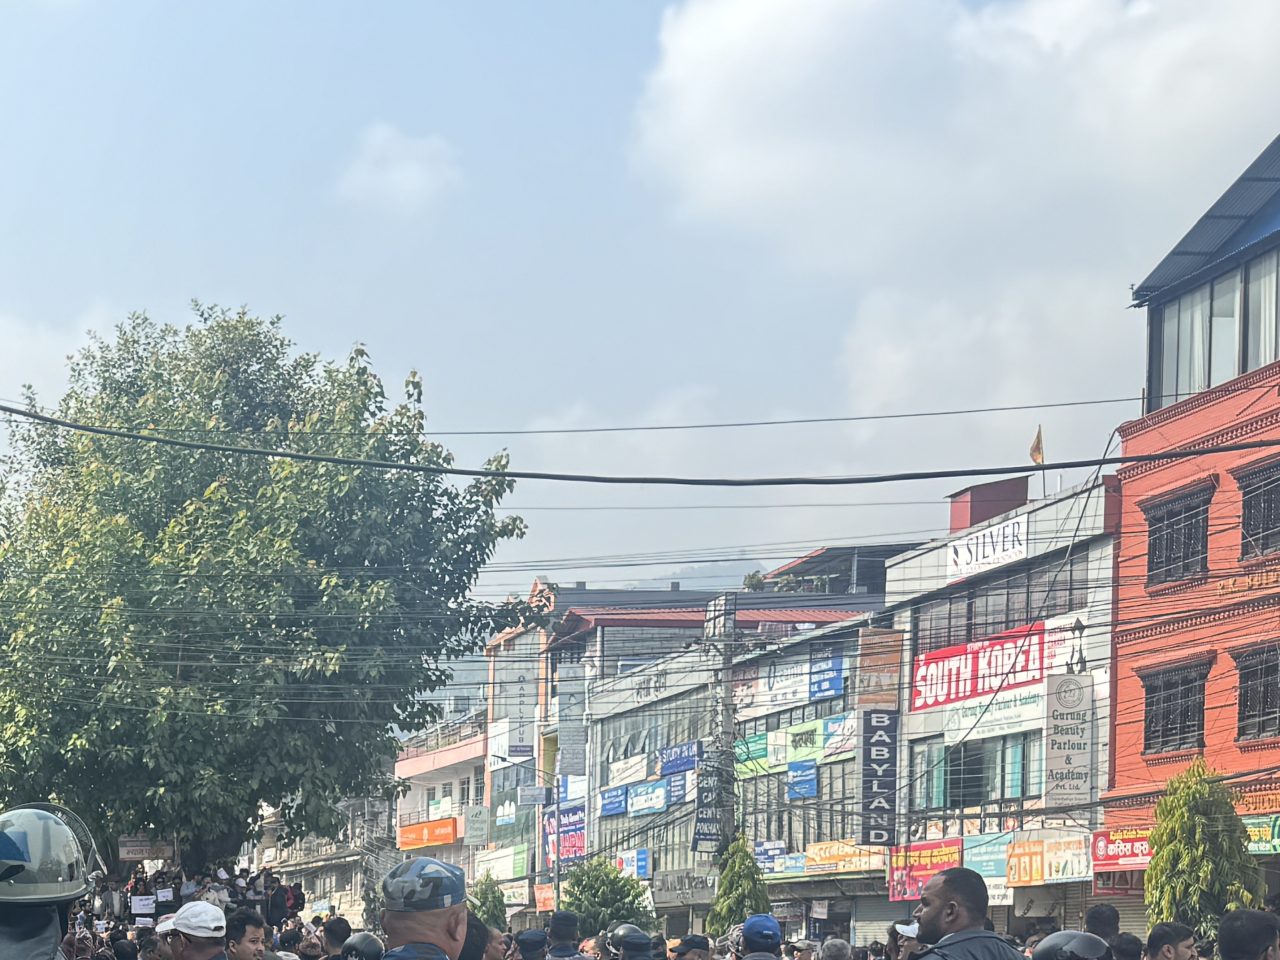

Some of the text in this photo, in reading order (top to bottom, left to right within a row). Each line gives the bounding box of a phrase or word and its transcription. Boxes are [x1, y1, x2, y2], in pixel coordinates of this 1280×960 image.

[965, 521, 1023, 566] SILVER
[914, 632, 1042, 708] SOUTH KOREA
[1052, 709, 1087, 723] Gurung
[1053, 724, 1086, 739] Beauty
[1051, 739, 1088, 751] Parlour
[1065, 754, 1073, 765] &
[869, 713, 892, 843] BABYLAND
[1048, 769, 1089, 784] Academy
